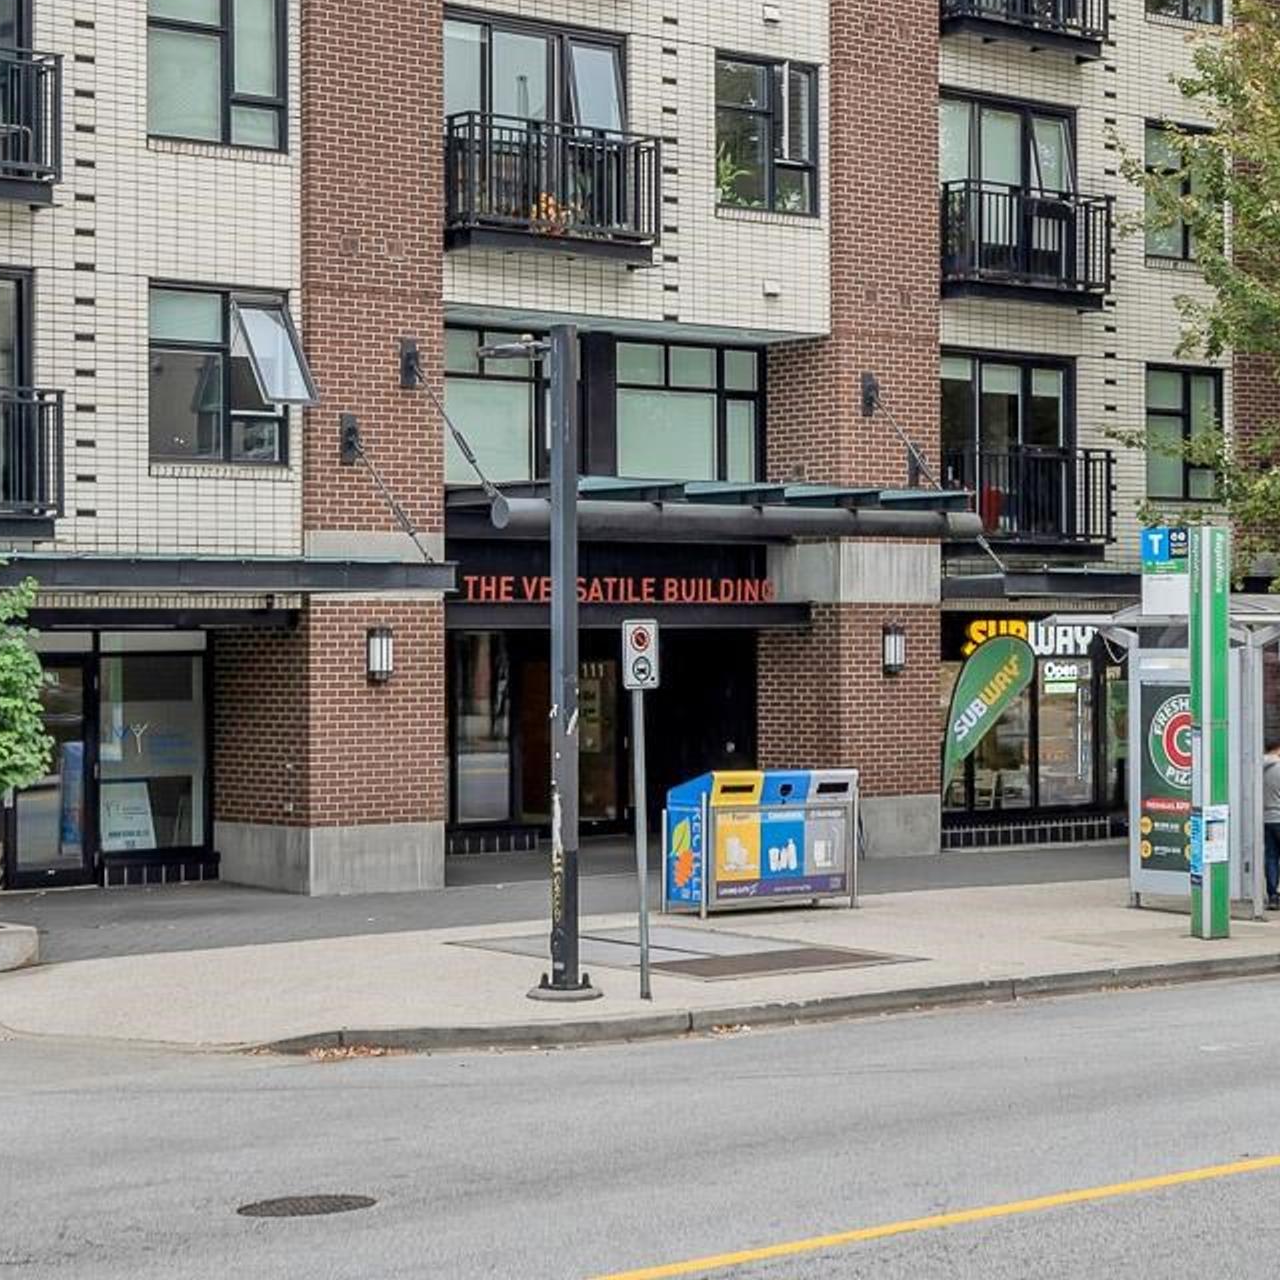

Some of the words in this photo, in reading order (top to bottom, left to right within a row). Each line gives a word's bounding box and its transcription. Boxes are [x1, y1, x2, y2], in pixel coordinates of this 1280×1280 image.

[464, 576, 514, 602] THE
[522, 576, 656, 603] VESATILE
[664, 577, 775, 603] BUILDING
[1044, 662, 1077, 677] Open
[954, 654, 1020, 742] SUBWAY
